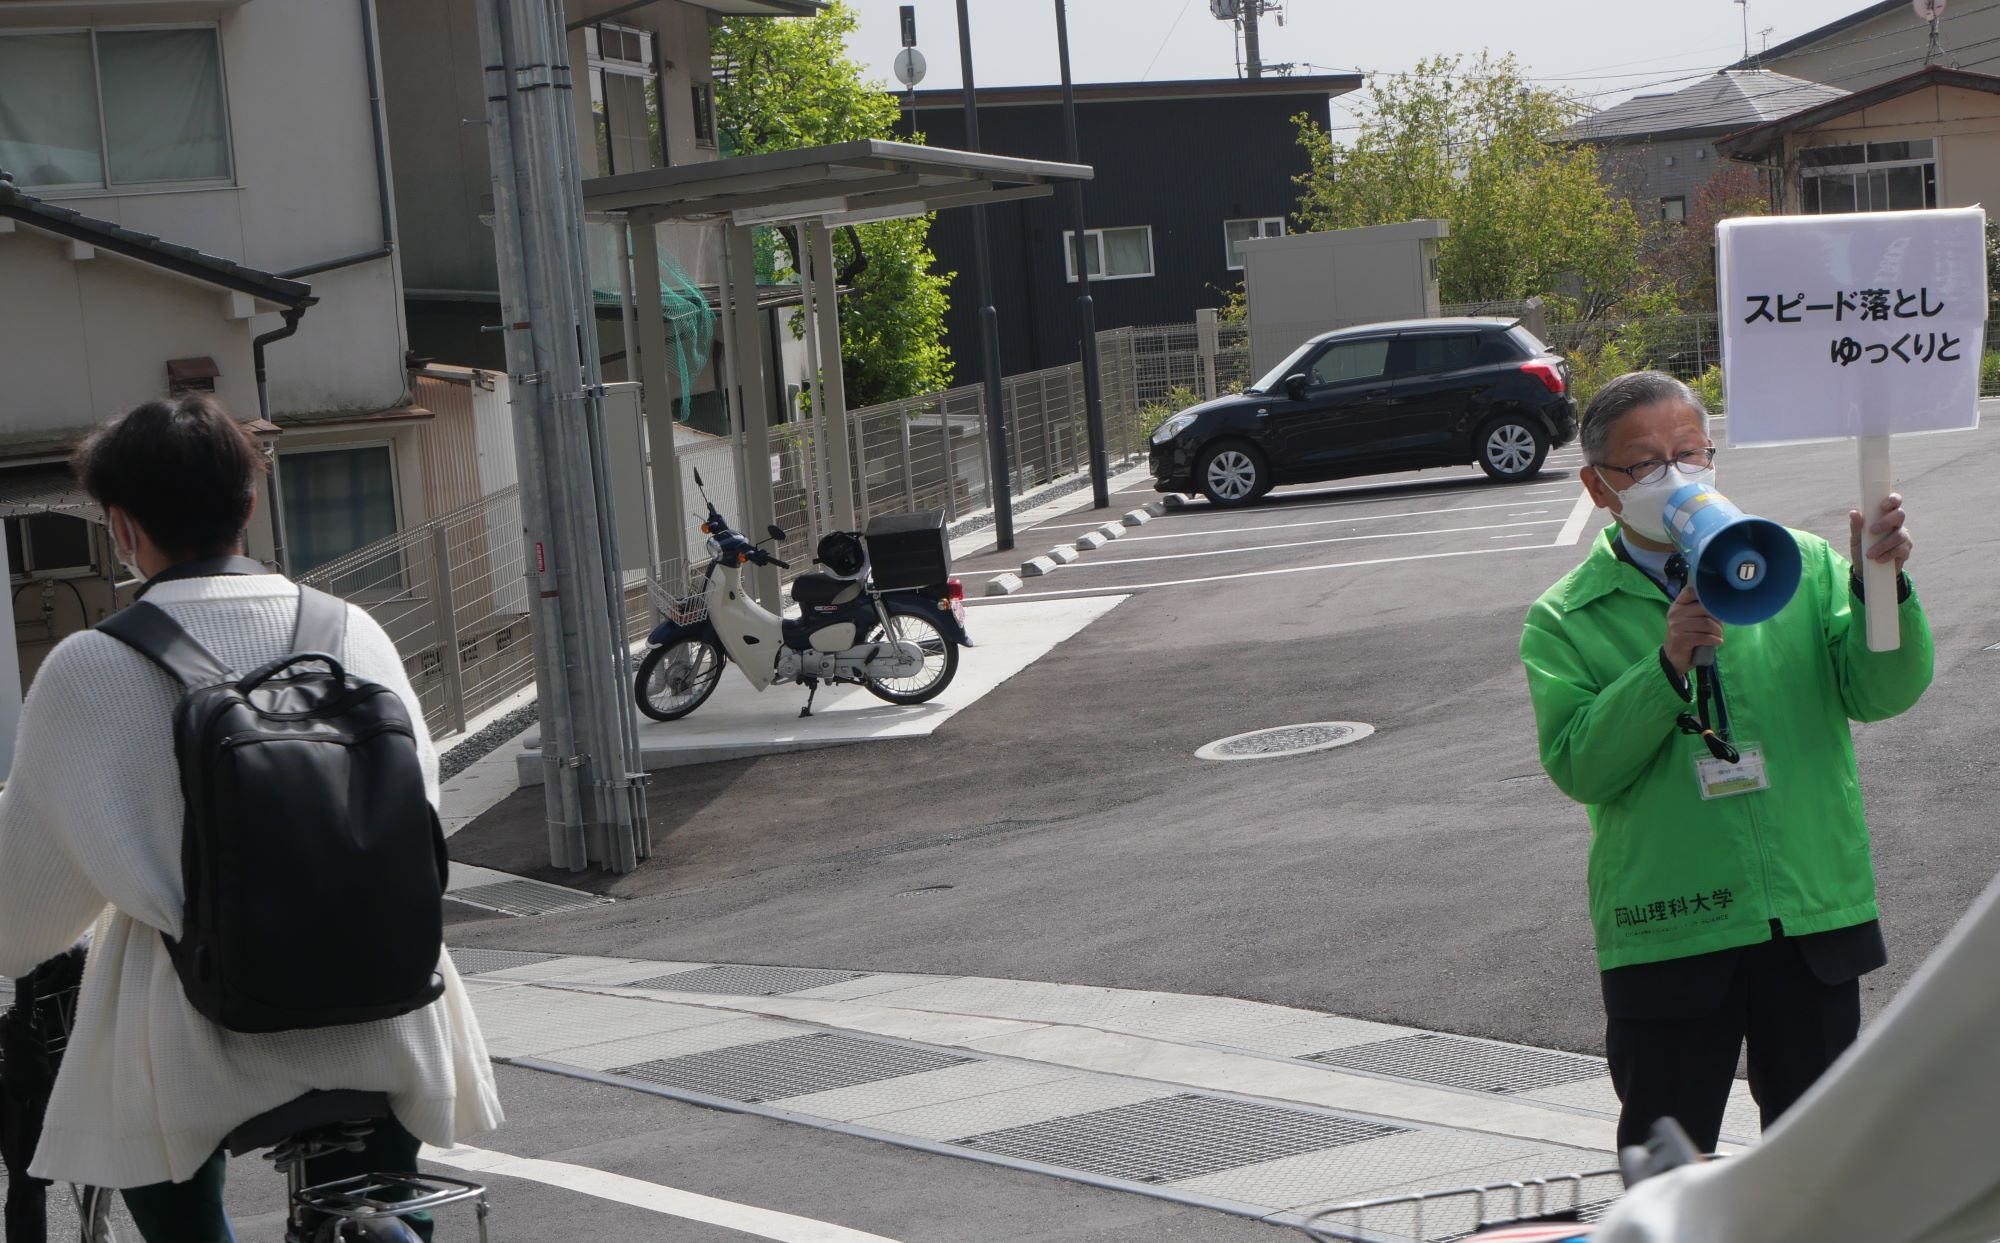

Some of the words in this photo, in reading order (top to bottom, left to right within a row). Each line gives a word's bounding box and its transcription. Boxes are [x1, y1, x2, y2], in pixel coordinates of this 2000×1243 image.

[1744, 287, 1945, 324] スピード落とし
[1830, 332, 1961, 366] ゆっくりと
[1614, 888, 1734, 927] 岡山理科大学
